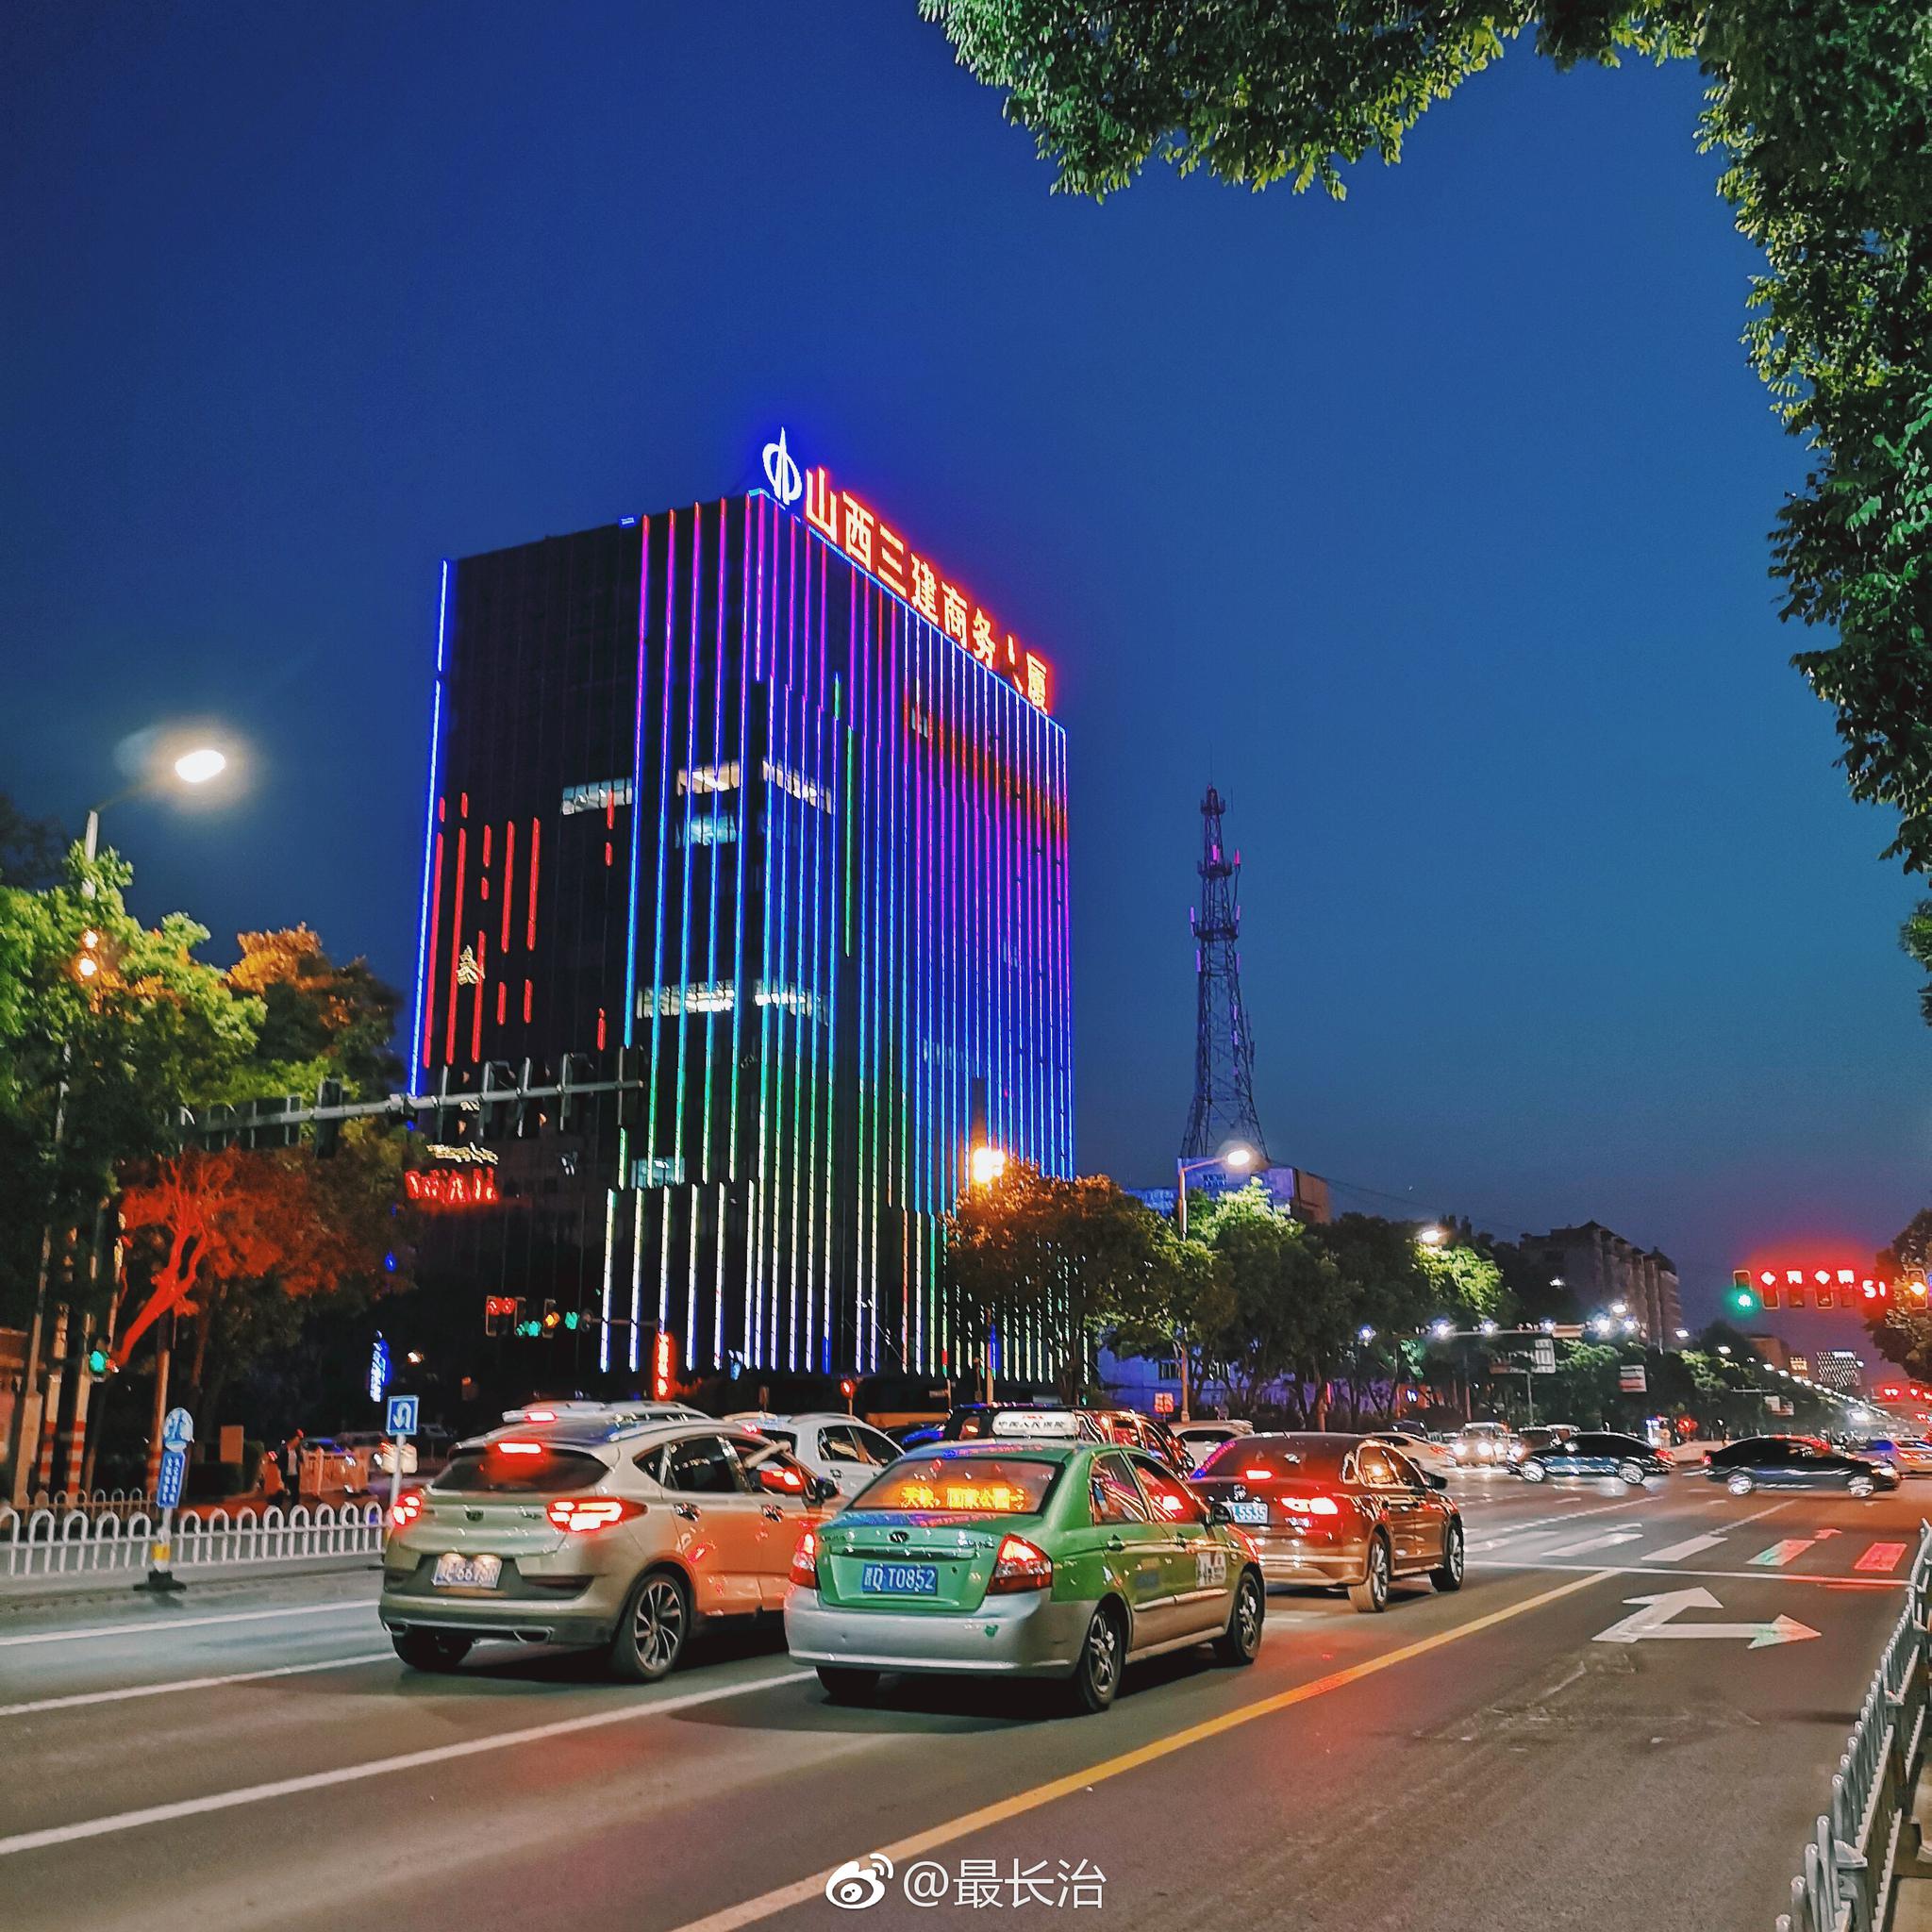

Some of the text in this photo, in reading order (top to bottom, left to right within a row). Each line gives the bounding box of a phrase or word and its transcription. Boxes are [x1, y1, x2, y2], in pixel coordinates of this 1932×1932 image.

[806, 466, 1048, 715] 山西三建商务厦
